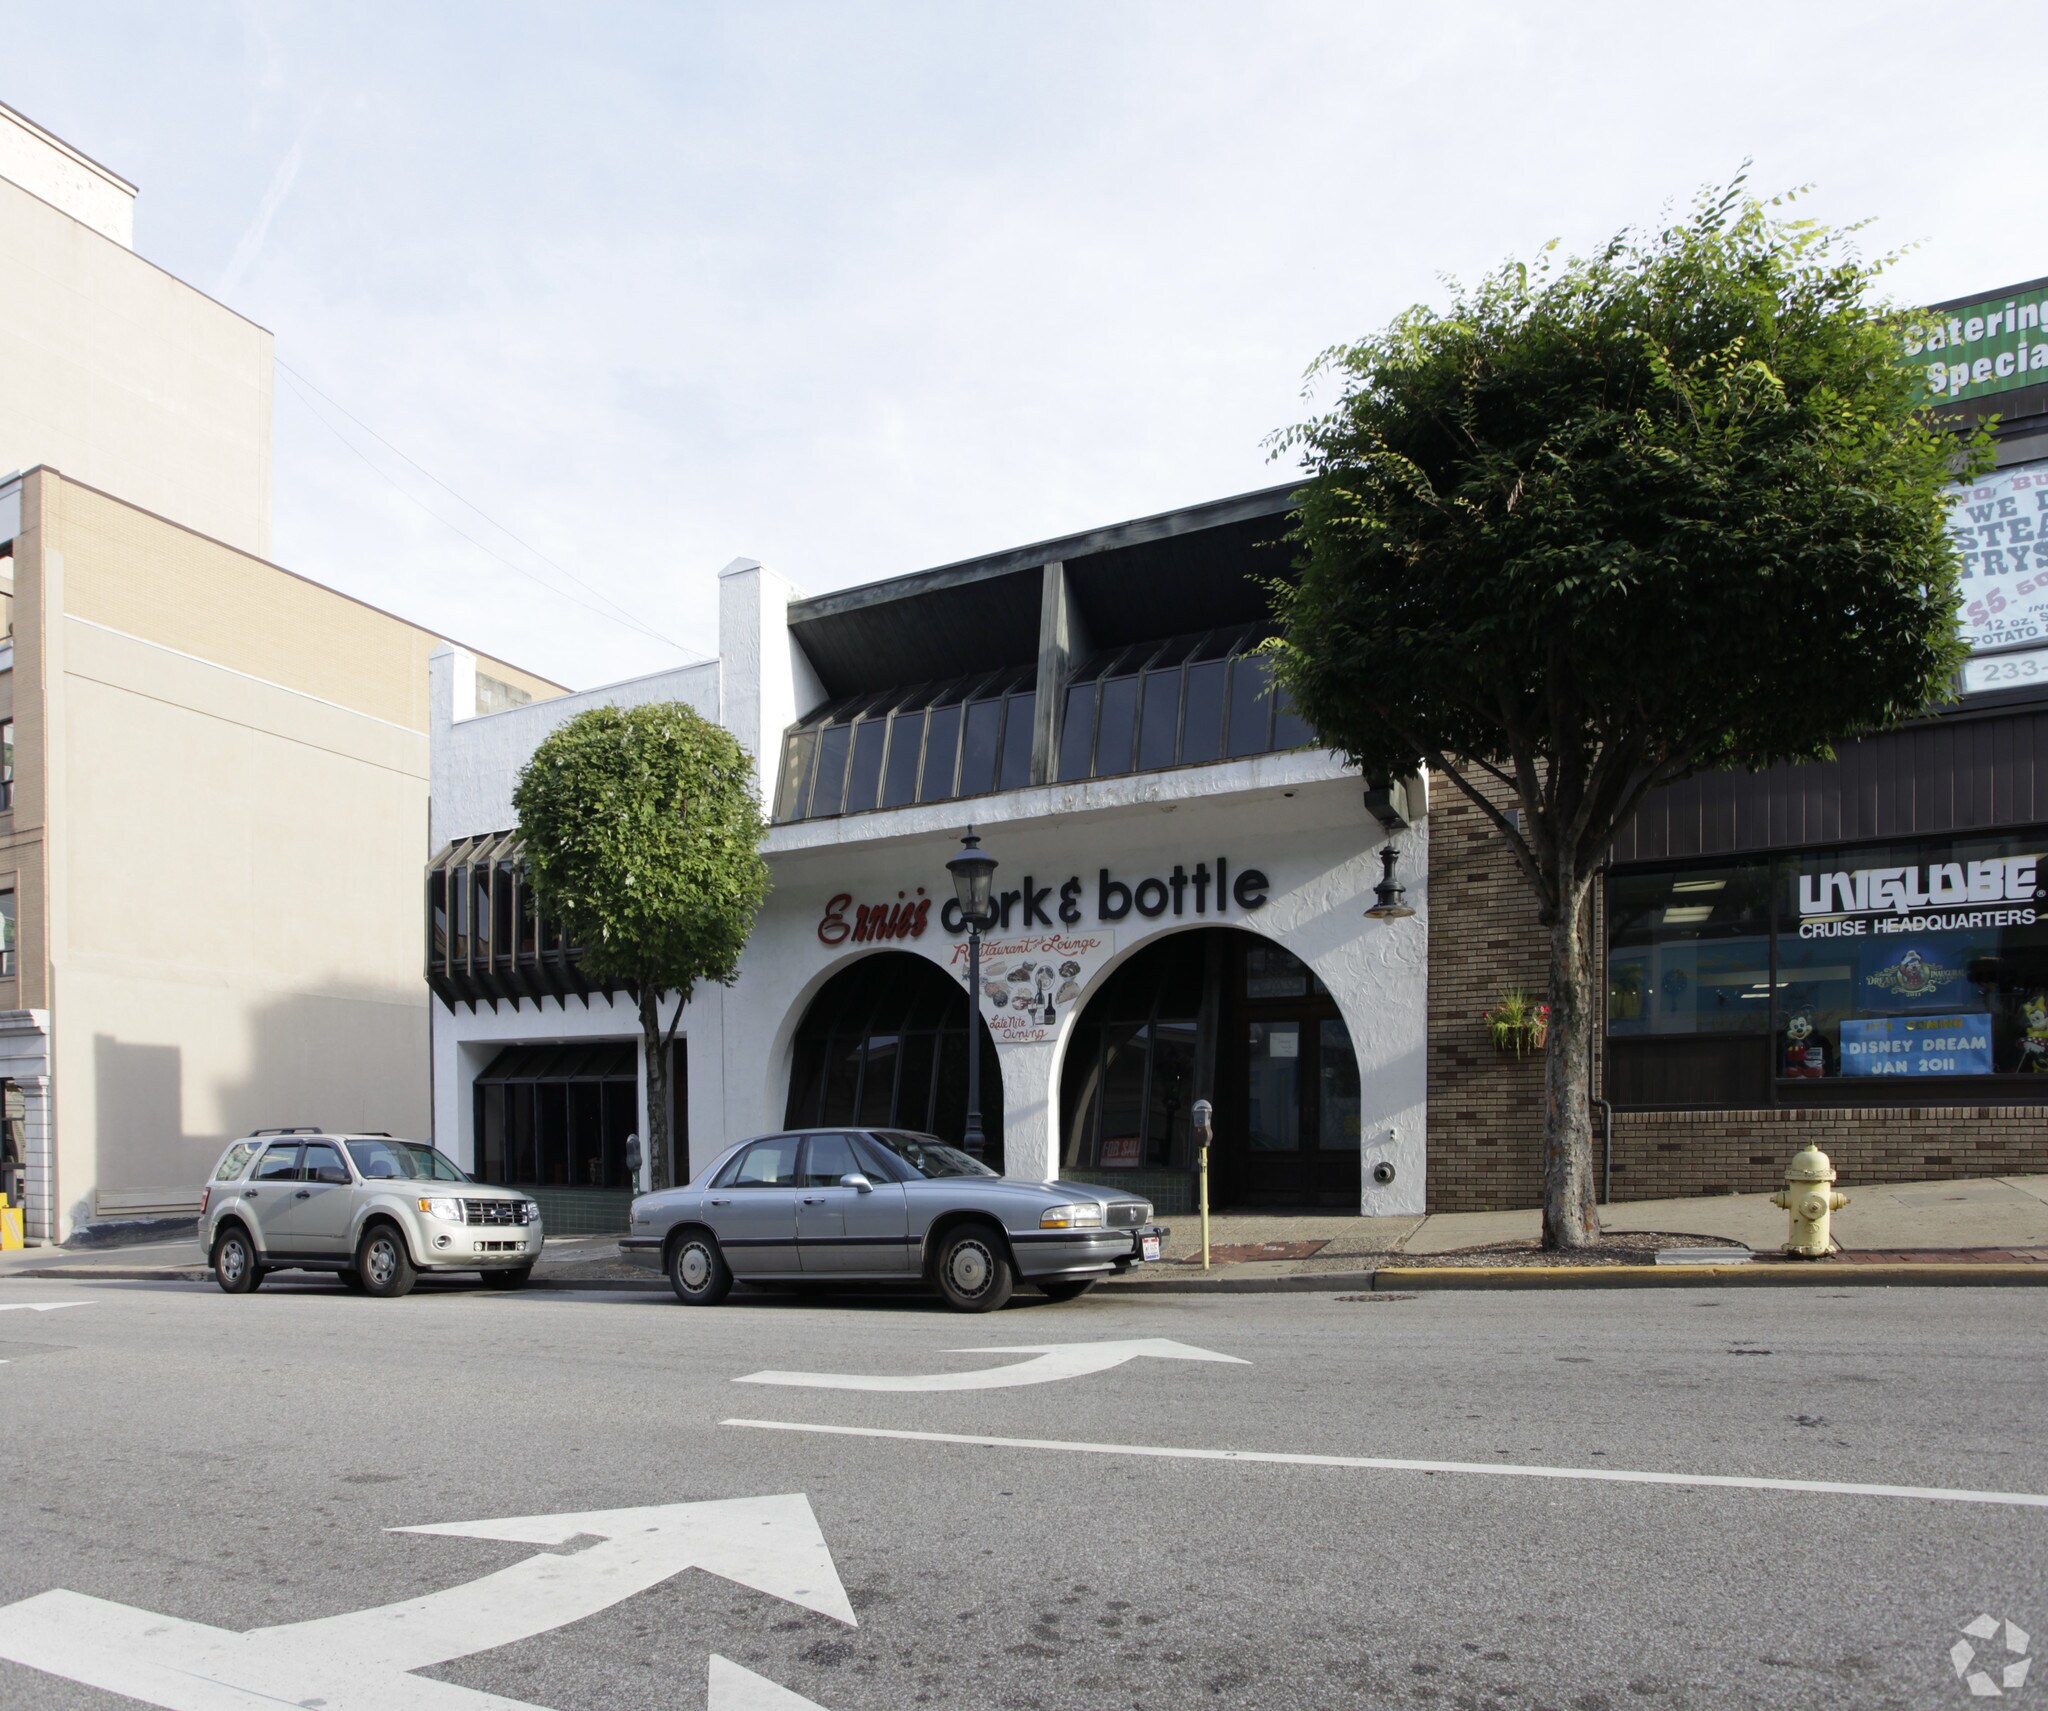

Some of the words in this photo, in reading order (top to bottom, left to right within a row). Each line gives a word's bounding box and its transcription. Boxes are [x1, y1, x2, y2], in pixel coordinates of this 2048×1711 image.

[1926, 342, 2048, 396] Specia
[1965, 497, 2018, 523] WE
[2028, 603, 2048, 613] IN
[1985, 619, 2005, 631] 12
[2010, 618, 2034, 628] oz.
[1971, 626, 2038, 646] POTATO
[1099, 857, 1270, 920] bottle
[1799, 919, 1867, 940] CRUISE
[1873, 908, 2036, 935] HEADQUARTERS
[951, 938, 1033, 966] Rstaurant
[1042, 934, 1101, 956] Lounge
[990, 1014, 1008, 1030] Late
[1007, 1015, 1026, 1029] Nite
[1003, 1029, 1048, 1041] Dining
[1849, 1040, 1913, 1055] DISNEY
[1922, 1036, 1987, 1052] DREAM
[1871, 1060, 1908, 1075] JAN
[1918, 1058, 1955, 1072] 2011
[1102, 1140, 1120, 1158] FOR
